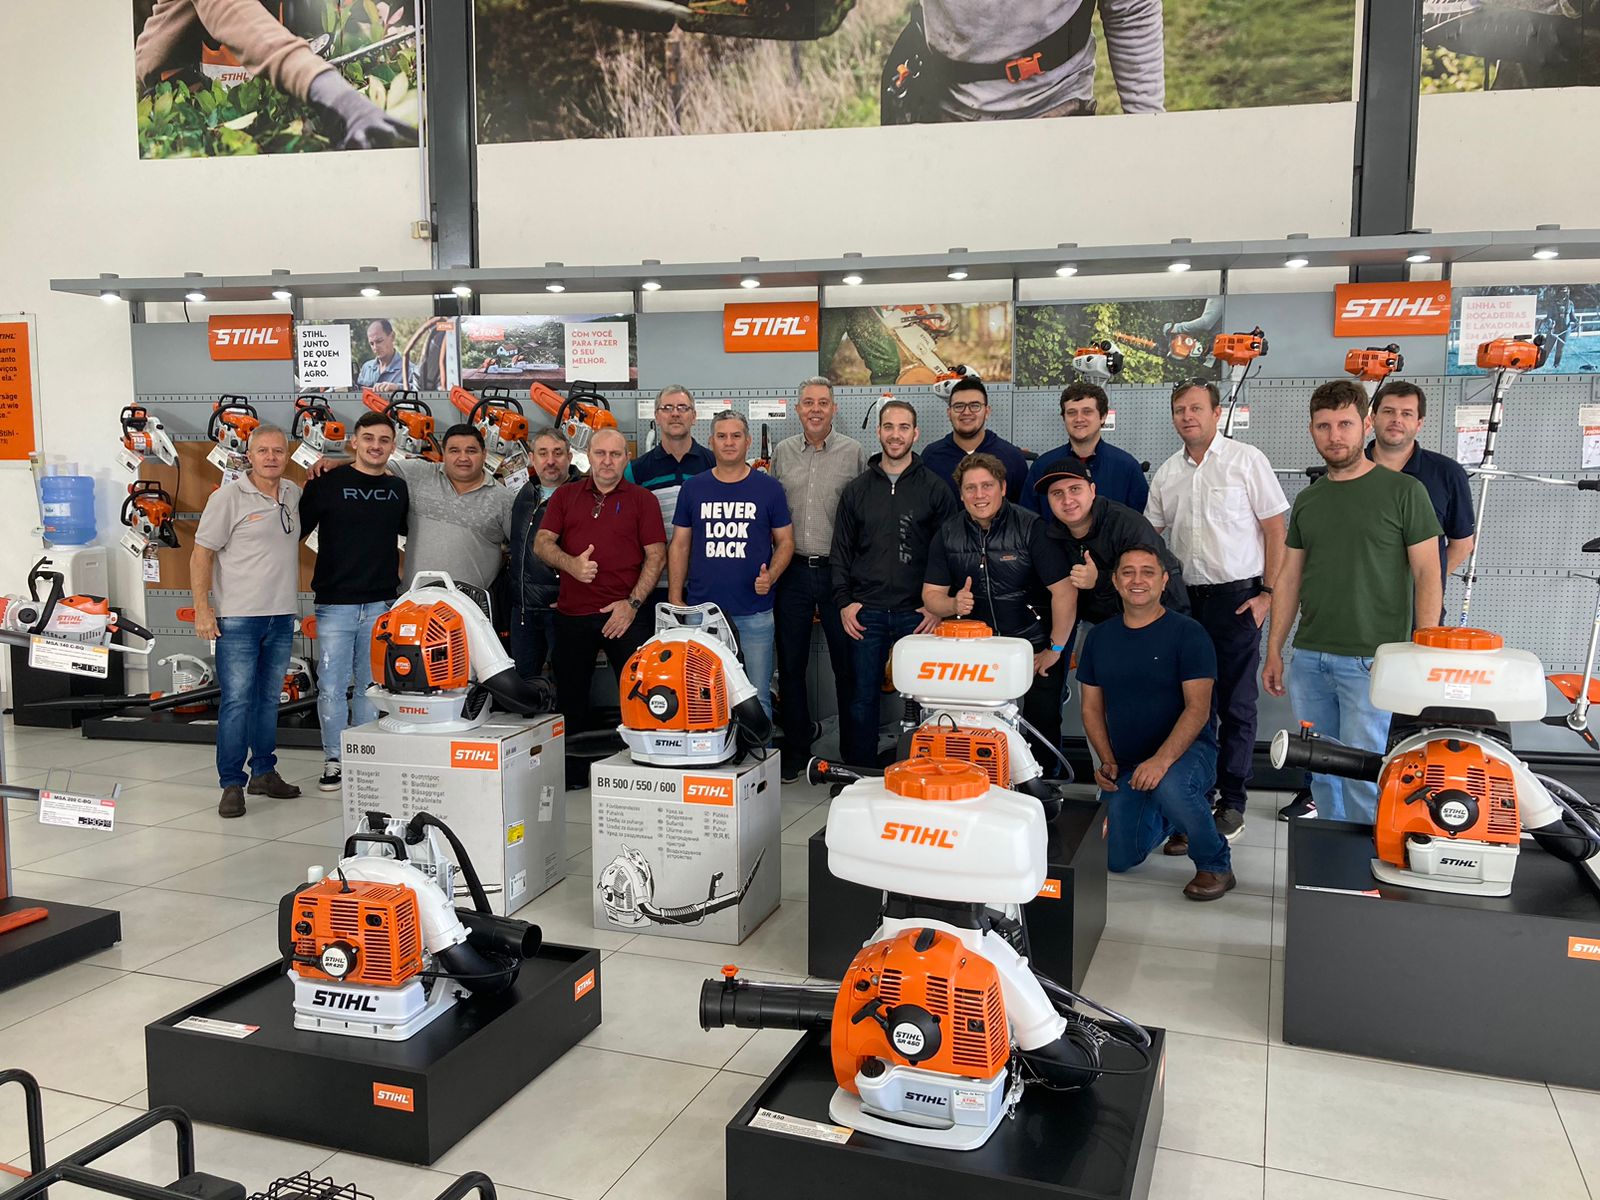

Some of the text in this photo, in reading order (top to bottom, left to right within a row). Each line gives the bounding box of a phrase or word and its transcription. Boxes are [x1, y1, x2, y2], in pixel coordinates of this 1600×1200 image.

[221, 72, 249, 81] STIHL
[1341, 298, 1441, 318] STIHL
[1466, 301, 1512, 310] LINHA DE
[1466, 312, 1527, 320] ROÇADEIRAS
[732, 317, 806, 336] STIHL
[1474, 321, 1531, 330] LAVADORAS
[216, 328, 279, 345] STIHL
[303, 330, 327, 338] STIHL.
[592, 329, 612, 338] VOCÊ
[594, 339, 618, 347] FAZER
[316, 350, 340, 358] QUEM
[572, 357, 607, 365] MELHOR.
[343, 488, 399, 500] RVCA
[700, 502, 757, 520] NEVER
[705, 522, 749, 539] LOOK
[705, 541, 746, 558] BACK
[917, 662, 995, 683] STIHL
[1427, 668, 1491, 684] STIHL
[399, 706, 428, 714] STIHL
[346, 743, 376, 755] BR 800
[655, 739, 682, 747] STIHL
[455, 749, 494, 762] STIHL
[597, 777, 676, 793] BR 500 / 550 / 600
[687, 784, 729, 797] STIHL
[881, 822, 954, 848] STIHL
[1440, 858, 1476, 867] STIHL
[1573, 943, 1600, 953] STIH
[312, 990, 376, 1012] STIHL
[895, 1031, 921, 1041] STIHL
[377, 1090, 408, 1104] STIHL
[905, 1091, 946, 1106] STIHL
